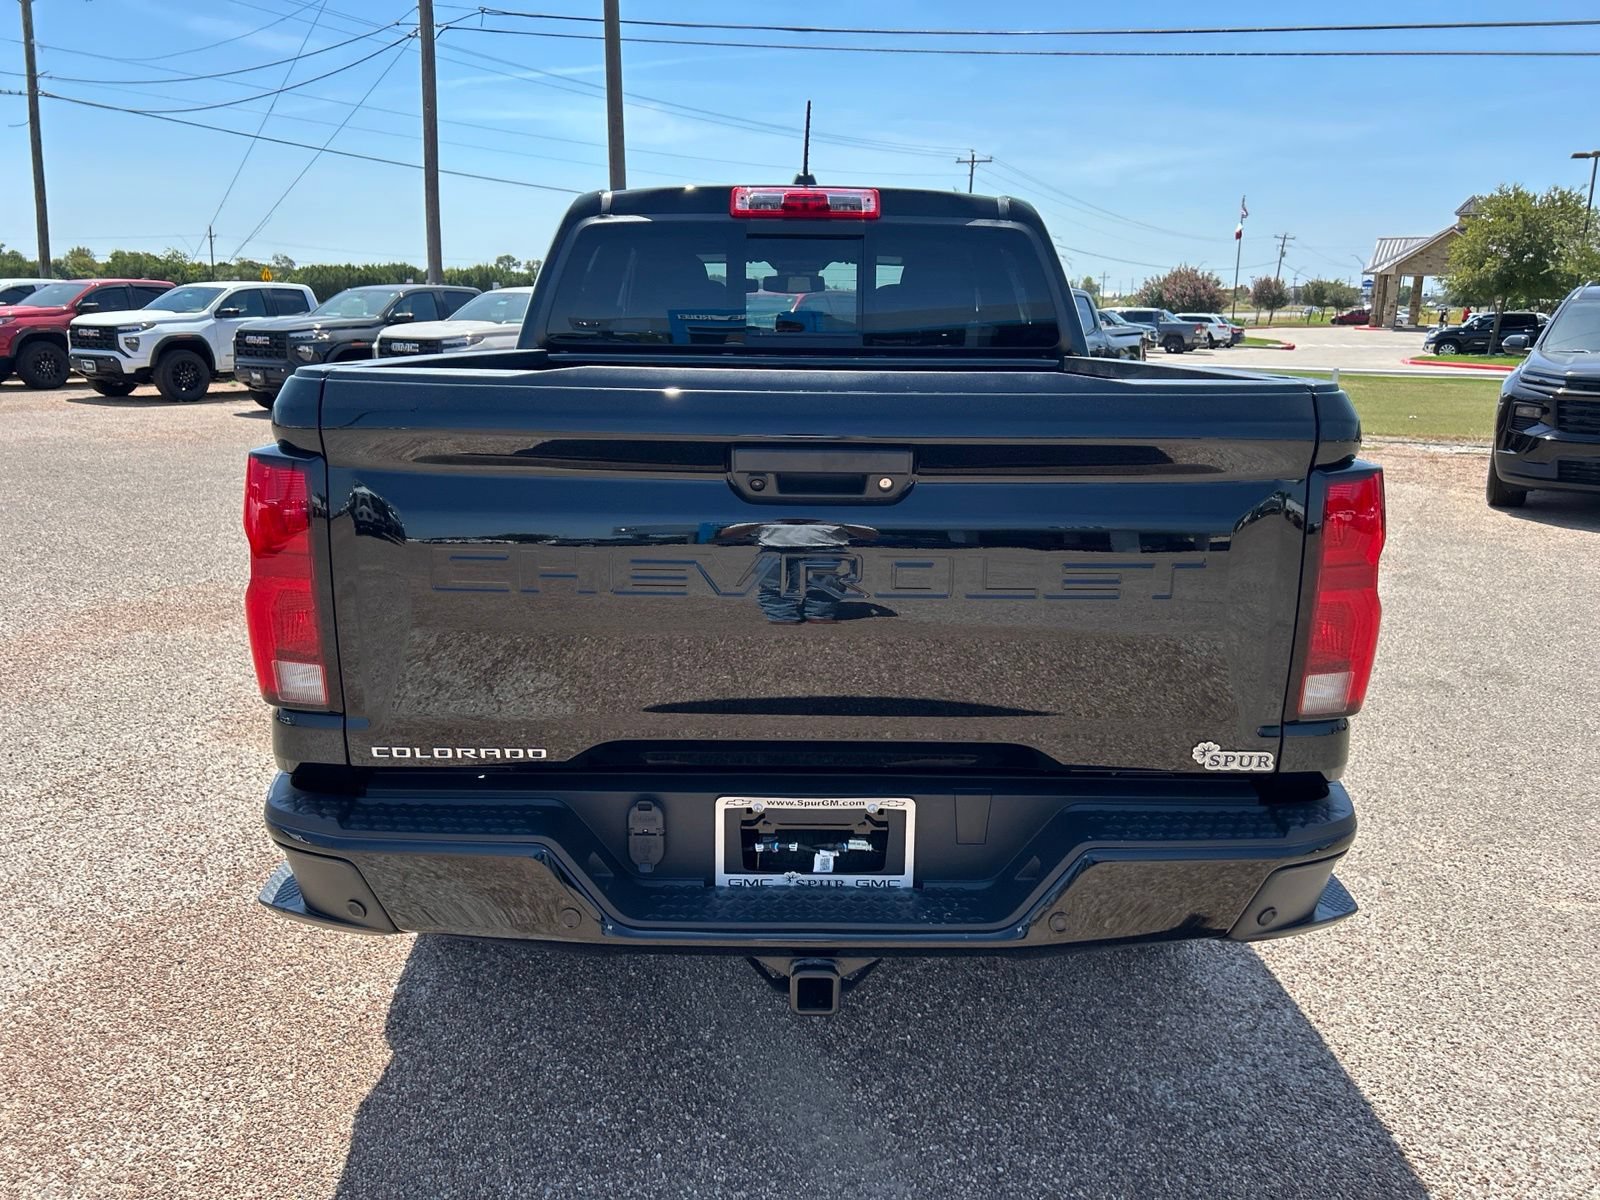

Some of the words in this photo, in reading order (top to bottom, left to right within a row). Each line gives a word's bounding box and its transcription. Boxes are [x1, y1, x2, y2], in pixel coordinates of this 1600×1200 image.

[78, 328, 100, 337] GMC
[245, 335, 270, 345] GMC
[391, 342, 419, 353] GMC
[431, 550, 1208, 598] CHEVROLET
[371, 747, 548, 759] COLORADO
[1208, 754, 1271, 768] SPUR
[766, 799, 865, 808] www.SpurGM.com
[728, 878, 774, 888] GMC
[855, 879, 901, 888] GMC
